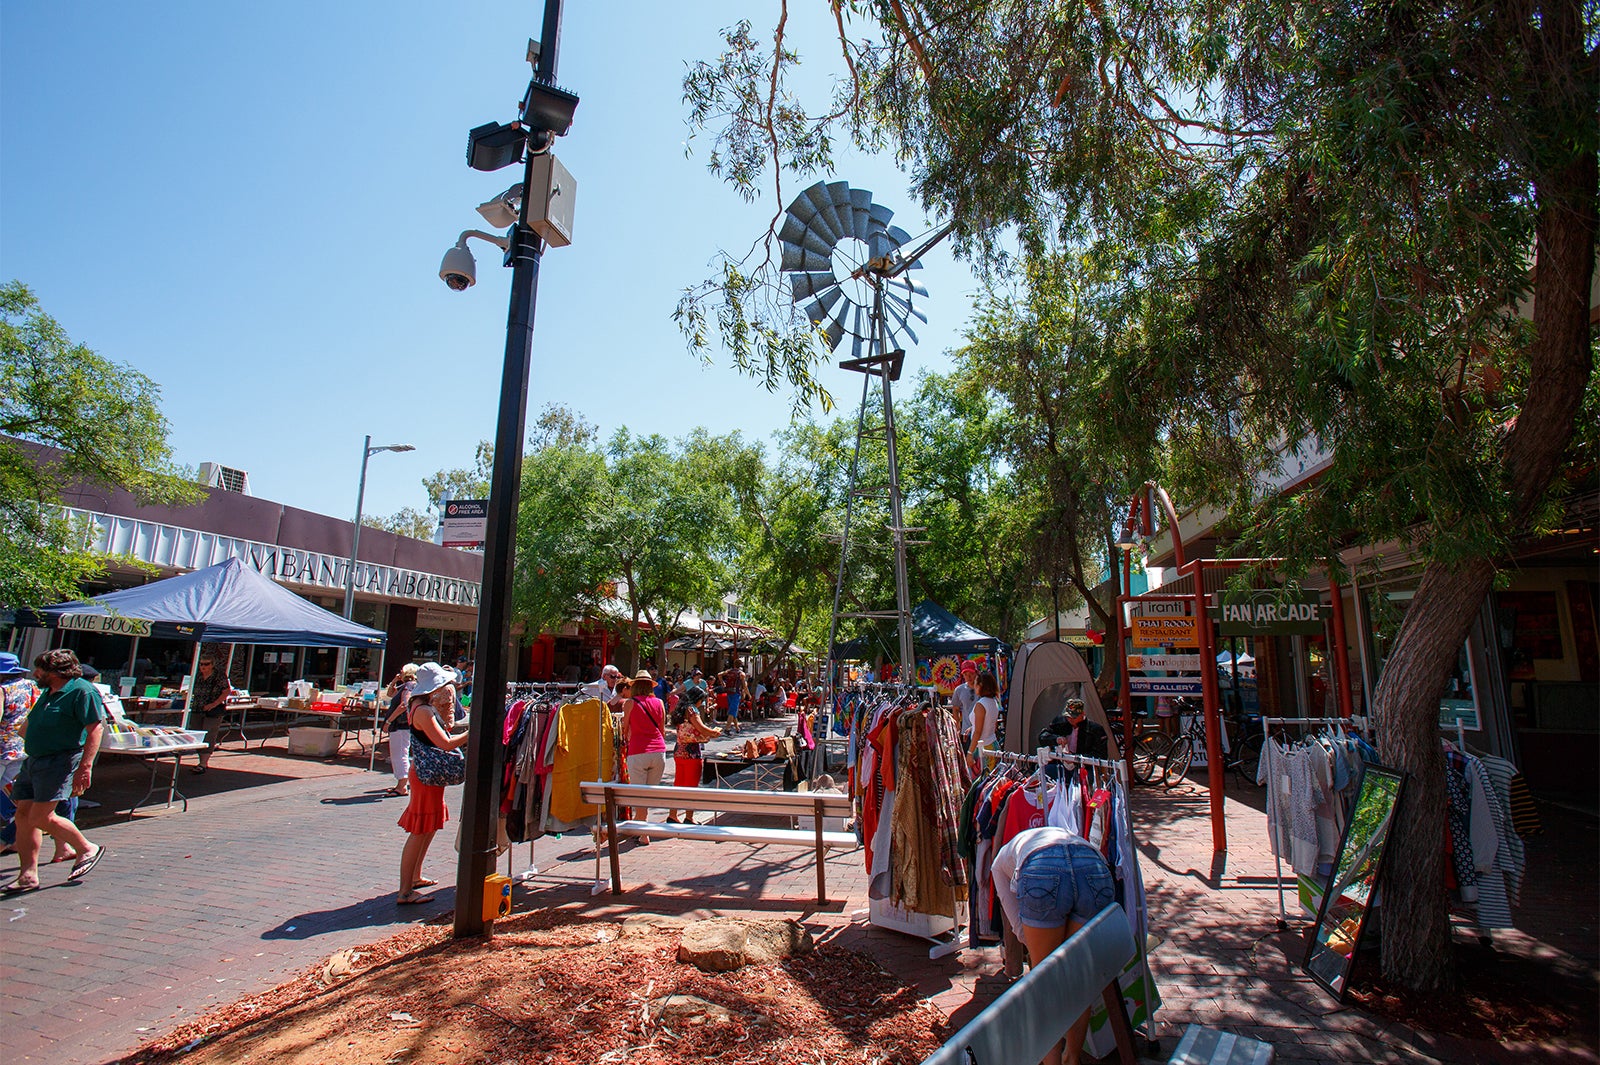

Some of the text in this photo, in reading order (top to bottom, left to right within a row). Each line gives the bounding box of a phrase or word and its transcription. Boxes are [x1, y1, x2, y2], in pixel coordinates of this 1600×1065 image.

[250, 548, 381, 591] MBANTUA
[1149, 602, 1182, 613] iranti
[1223, 603, 1320, 622] FAN ARCADE
[1137, 620, 1194, 628] THAI ROOM
